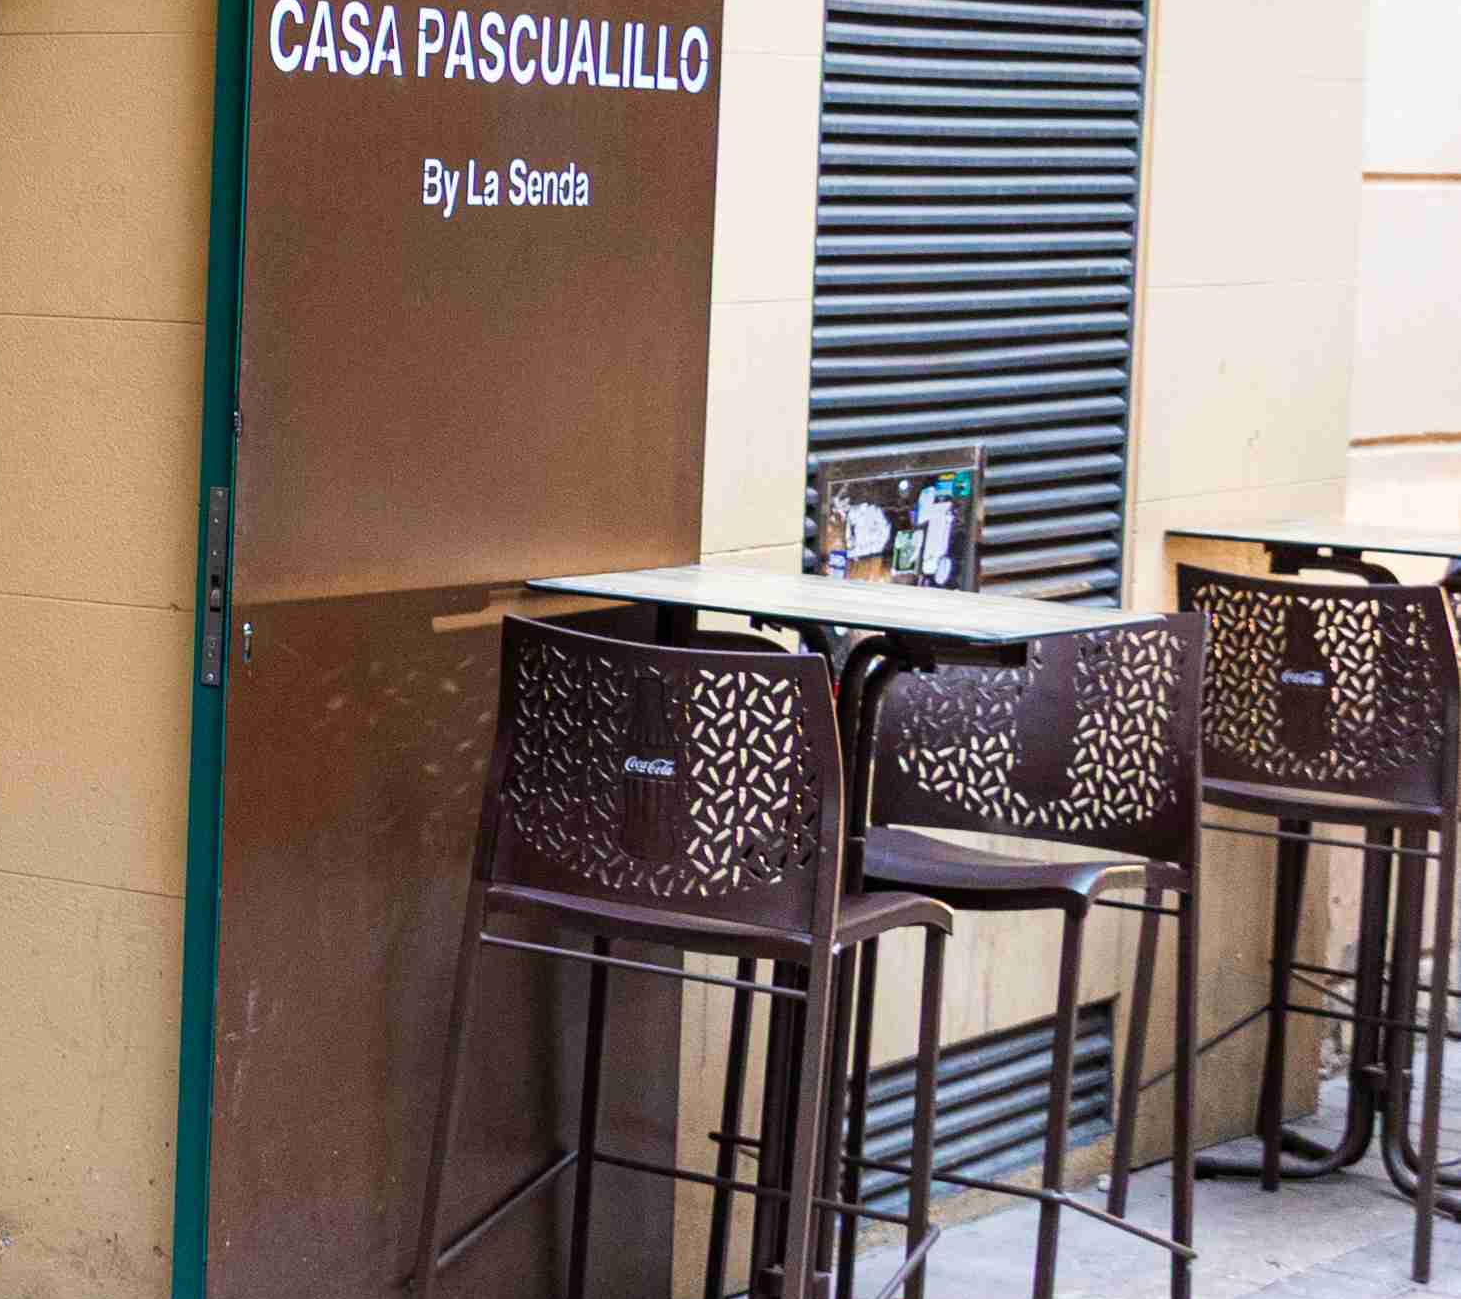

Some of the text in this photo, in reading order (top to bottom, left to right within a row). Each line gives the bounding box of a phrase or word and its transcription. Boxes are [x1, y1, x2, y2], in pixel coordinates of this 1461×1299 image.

[418, 7, 710, 94] PASCUALILLO
[422, 158, 589, 218] By La Senda
